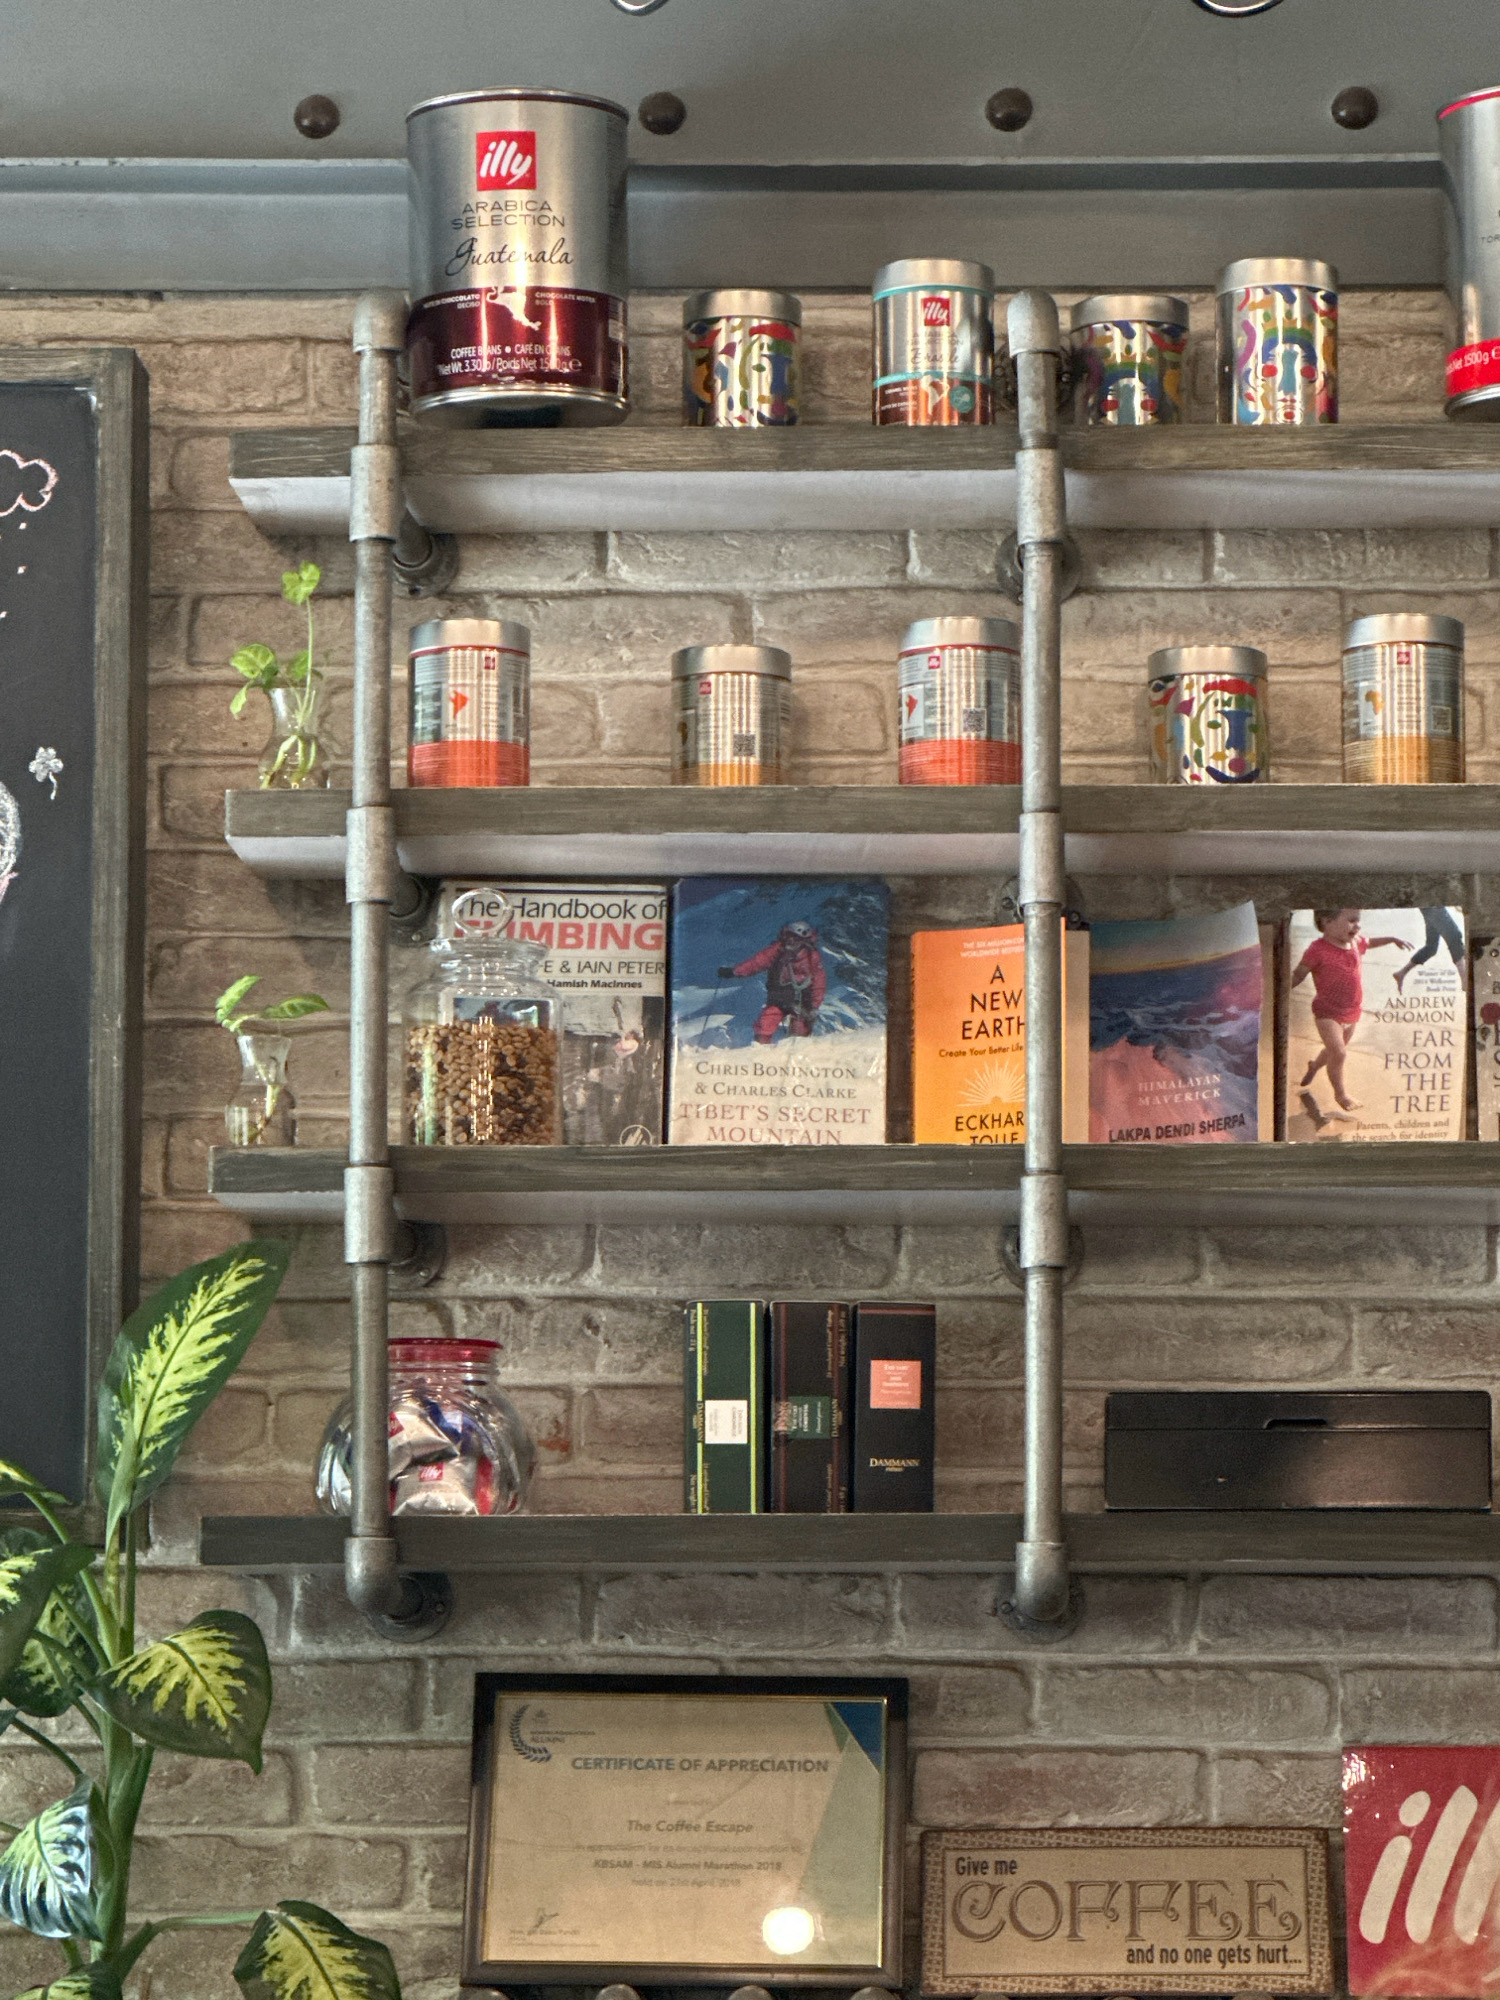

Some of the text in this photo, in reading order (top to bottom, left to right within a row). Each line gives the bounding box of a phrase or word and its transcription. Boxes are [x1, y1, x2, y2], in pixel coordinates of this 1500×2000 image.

[480, 139, 532, 185] illy
[462, 200, 553, 214] ARABICA
[451, 214, 565, 230] SELECTION
[924, 301, 948, 325] illy
[450, 344, 502, 359] COFFEE BANS
[512, 897, 637, 919] Handbook
[642, 898, 668, 919] of
[560, 960, 571, 973] &
[577, 960, 612, 974] IAIN
[618, 961, 665, 975] PETER
[990, 964, 1005, 985] A
[970, 988, 1023, 1013] NEW
[1384, 996, 1456, 1009] ANDREW
[1374, 1010, 1455, 1023] SOLOMON
[1412, 1031, 1455, 1047] FAR
[939, 1042, 1024, 1058] Create Your Better Life
[696, 1061, 858, 1079] CHRIS BONINGTON
[1384, 1052, 1452, 1070] FROM
[695, 1082, 857, 1099] & CHARLES CLARKE
[1138, 1073, 1222, 1092] HIMALAYAN
[1402, 1073, 1451, 1091] THE
[1138, 1088, 1221, 1107] MAVERICK
[1389, 1094, 1450, 1113] TREE
[679, 1103, 872, 1124] TIBET'S SECRET
[707, 1126, 843, 1145] MOUNTAIN
[1109, 1112, 1246, 1142] LAKPA DENDI SHERPA
[869, 1458, 920, 1467] DAMMANN
[571, 1757, 829, 1773] CERTIFICATE OF APPRECIATION
[627, 1820, 753, 1835] The Coffee Escape
[955, 1856, 1018, 1876] Give me
[952, 1879, 1302, 1943] COFFEE
[1126, 1943, 1302, 1969] and no one gets hurt...
